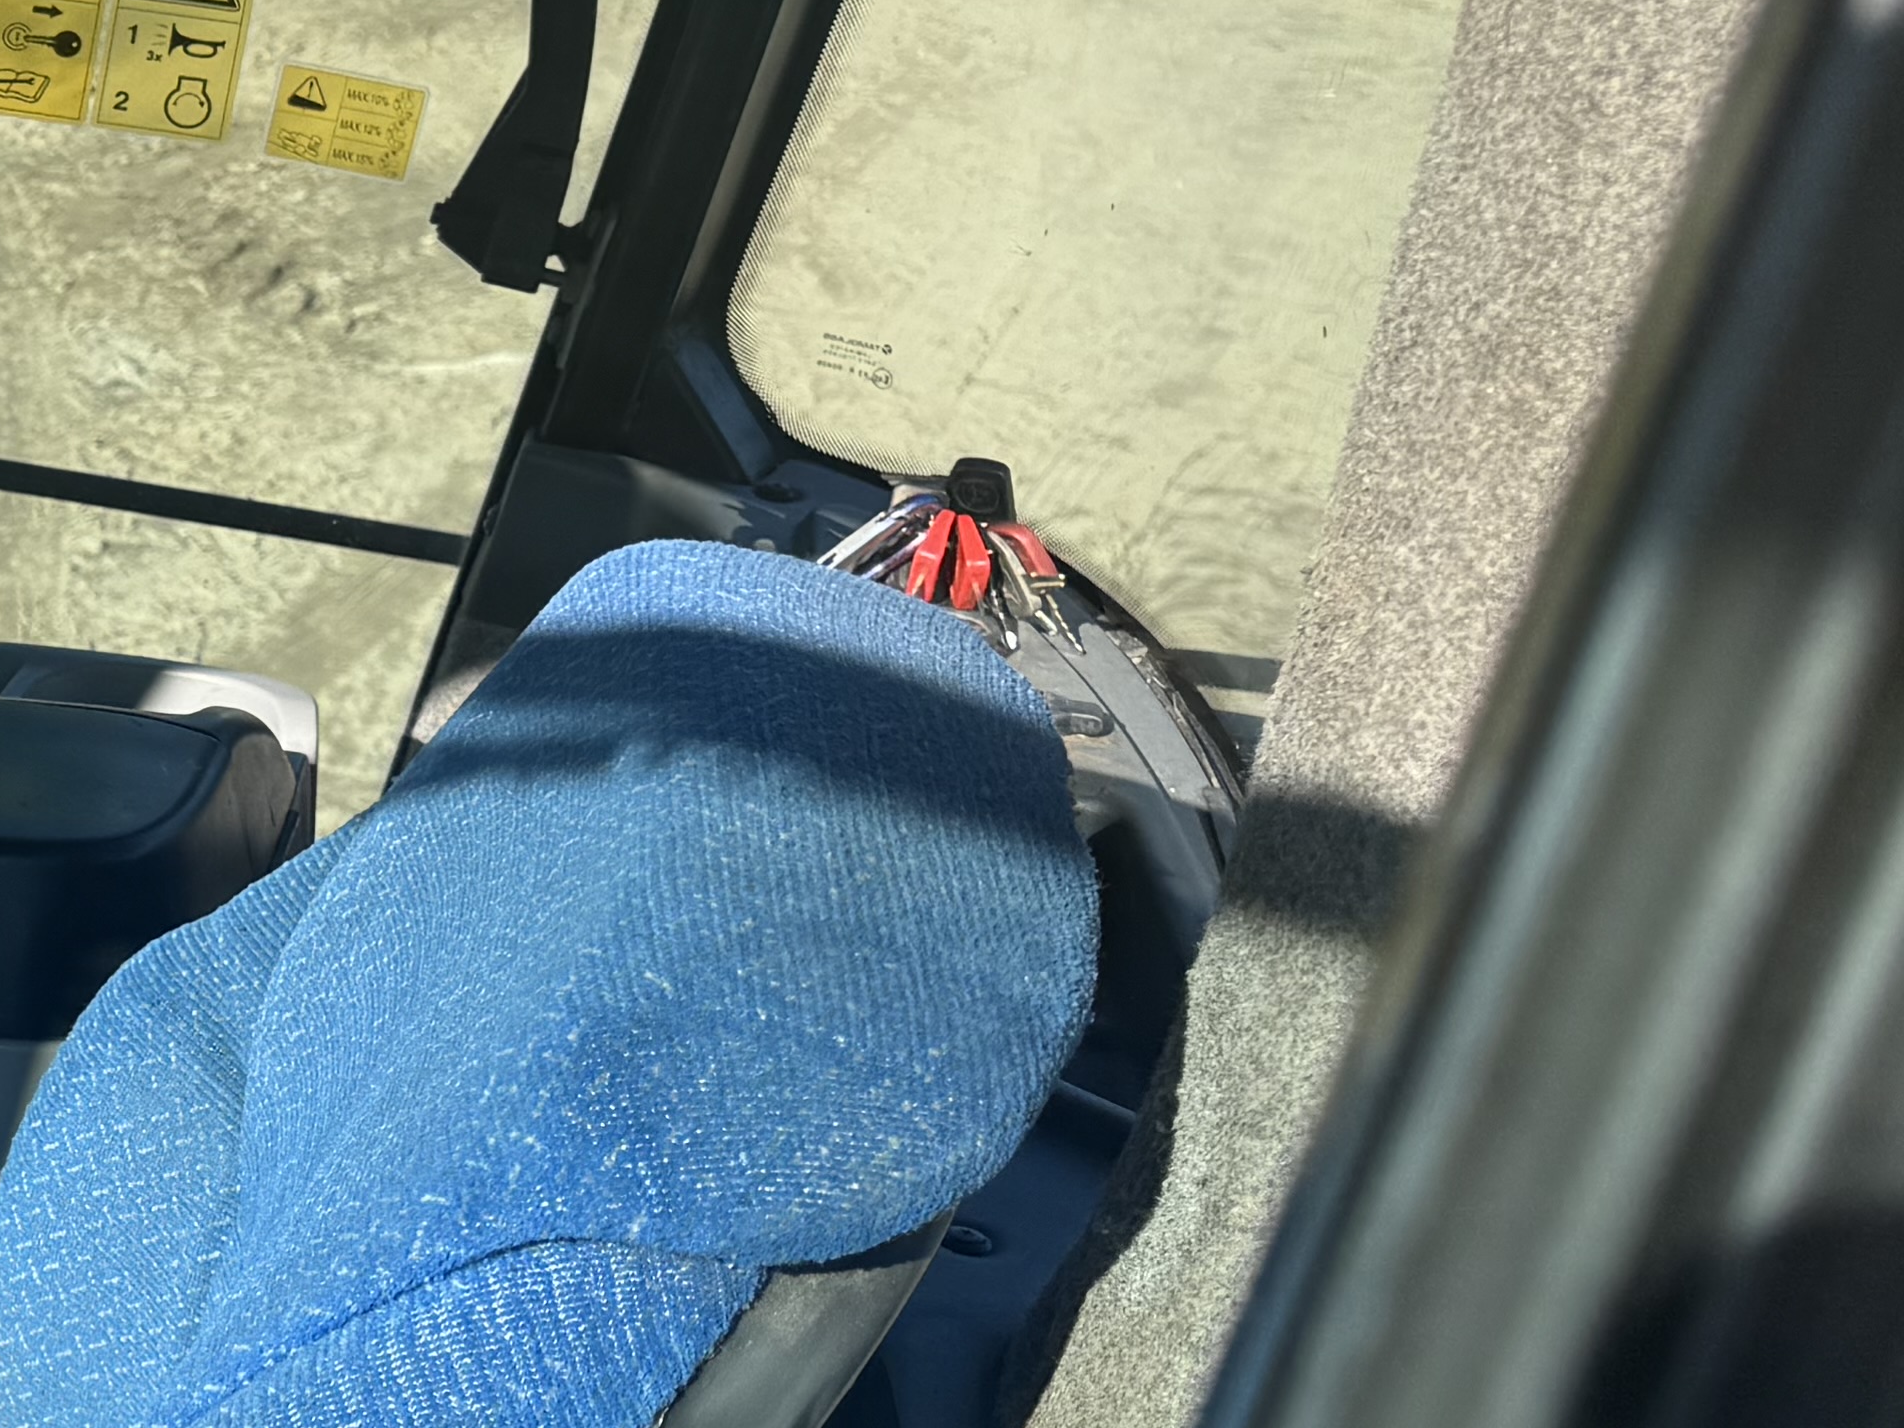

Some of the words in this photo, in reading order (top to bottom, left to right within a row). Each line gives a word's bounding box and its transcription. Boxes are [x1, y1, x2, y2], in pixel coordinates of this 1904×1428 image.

[127, 24, 139, 45] 1
[145, 49, 163, 63] 3x
[112, 90, 130, 112] 2
[347, 87, 369, 103] MAX
[339, 118, 361, 134] MAX
[332, 147, 354, 163] MAX
